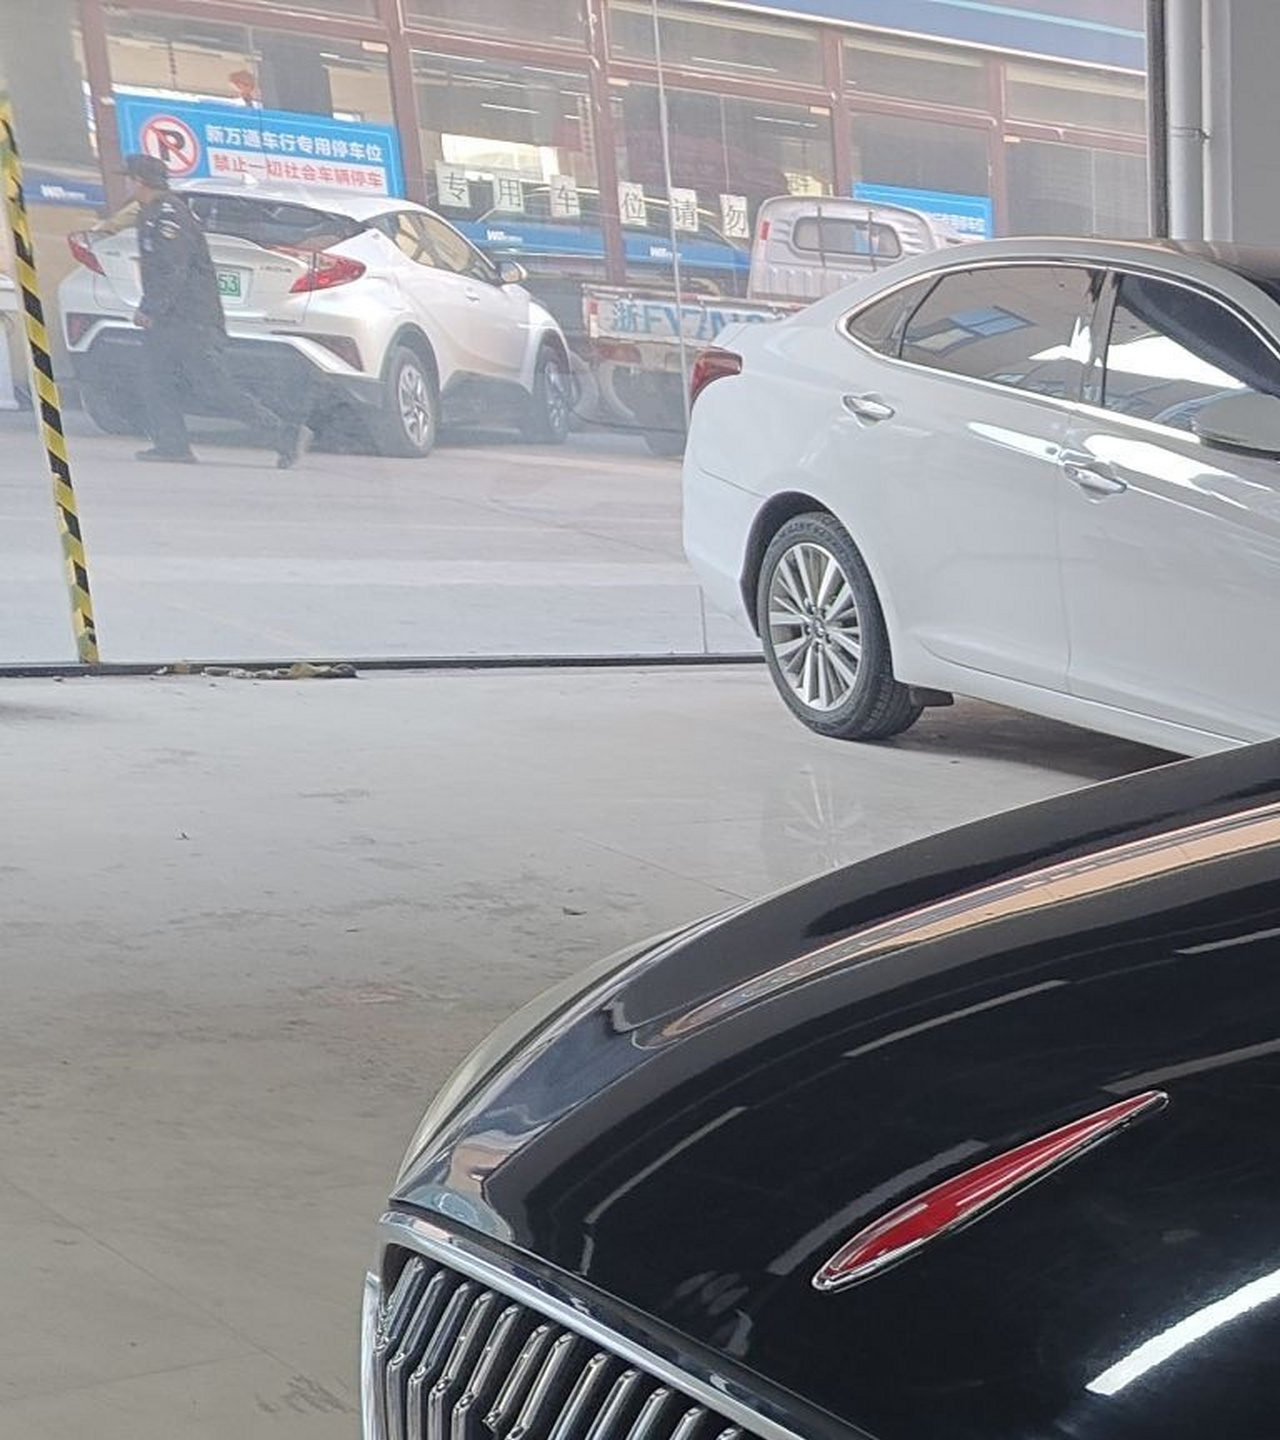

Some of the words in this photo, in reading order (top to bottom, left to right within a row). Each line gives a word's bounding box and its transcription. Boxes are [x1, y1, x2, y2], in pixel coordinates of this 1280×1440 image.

[205, 124, 384, 163] 新万通车行专用停车位
[213, 153, 384, 188] 禁止一切社会车辆停车
